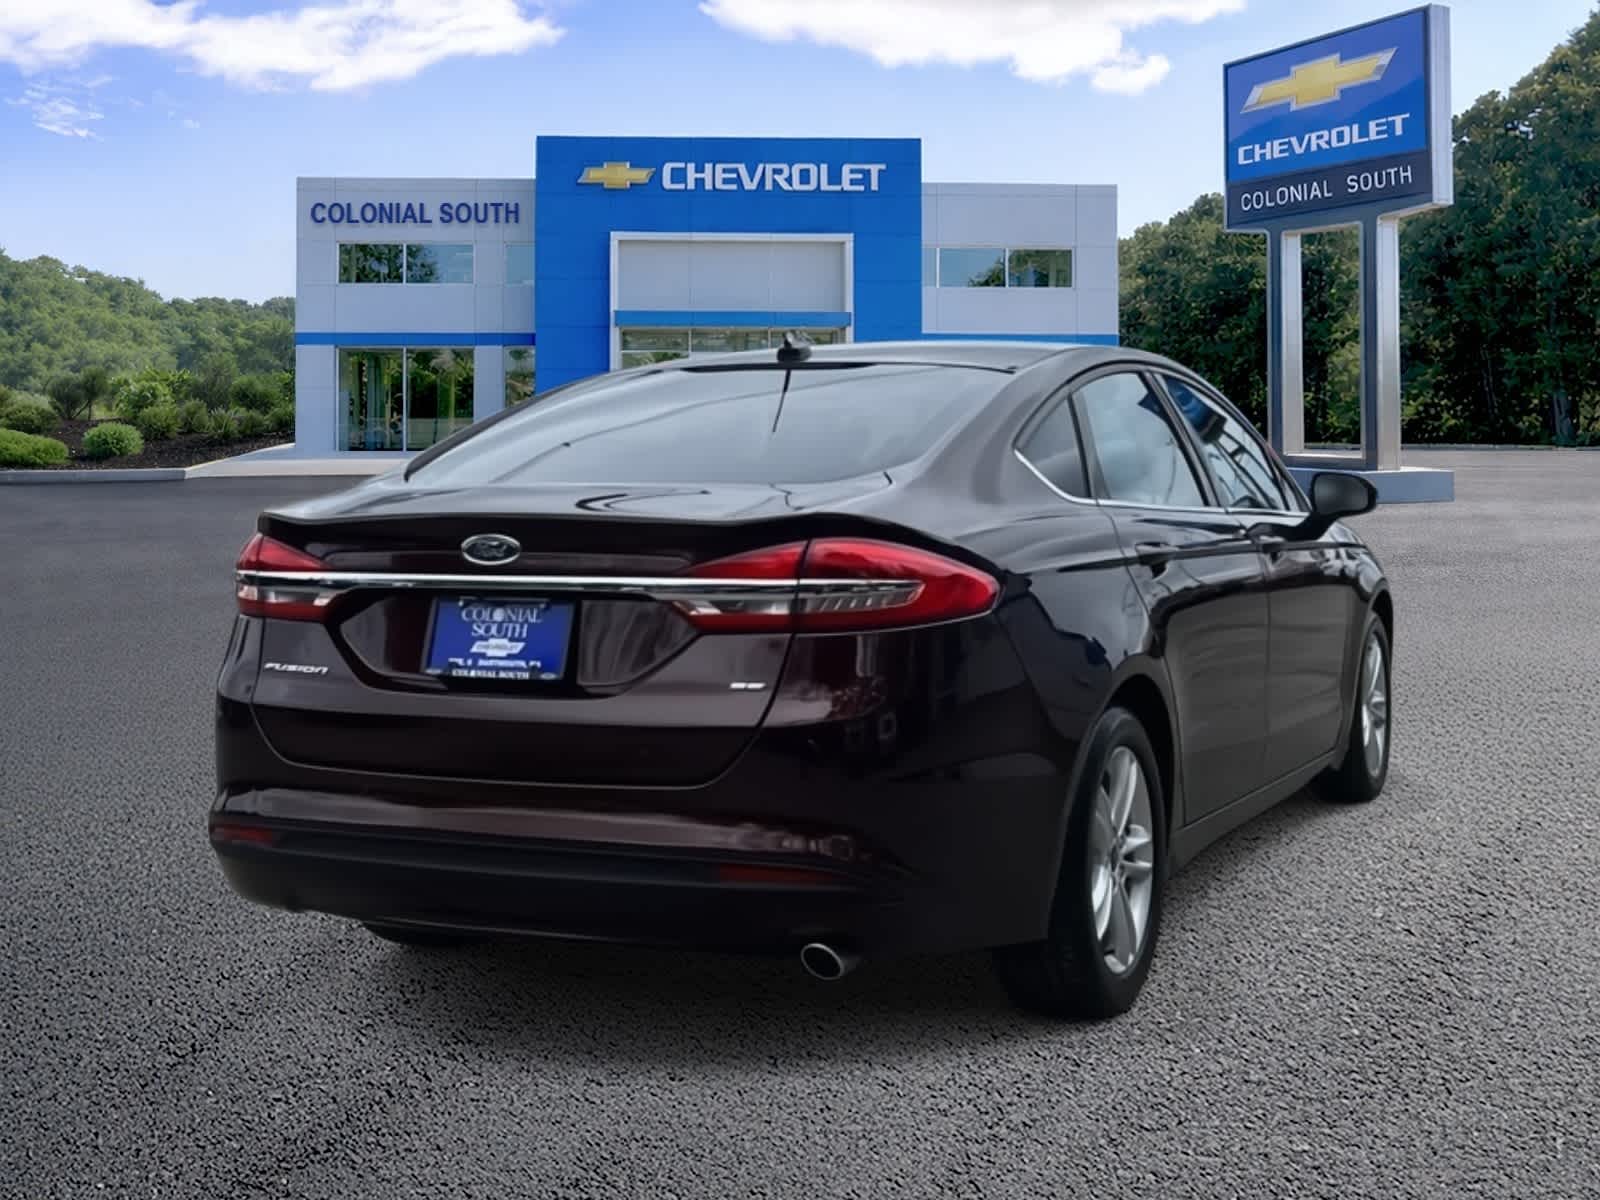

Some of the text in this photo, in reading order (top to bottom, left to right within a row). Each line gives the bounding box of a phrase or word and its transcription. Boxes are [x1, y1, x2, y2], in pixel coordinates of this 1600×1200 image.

[1238, 113, 1410, 165] CHEVROLET
[662, 162, 886, 191] CHEVROLET
[1241, 165, 1413, 211] COLONIAL SOUTH
[310, 202, 520, 224] COLONIAL SOUTH
[461, 607, 543, 623] COLONIAL
[471, 622, 528, 638] SOUTH
